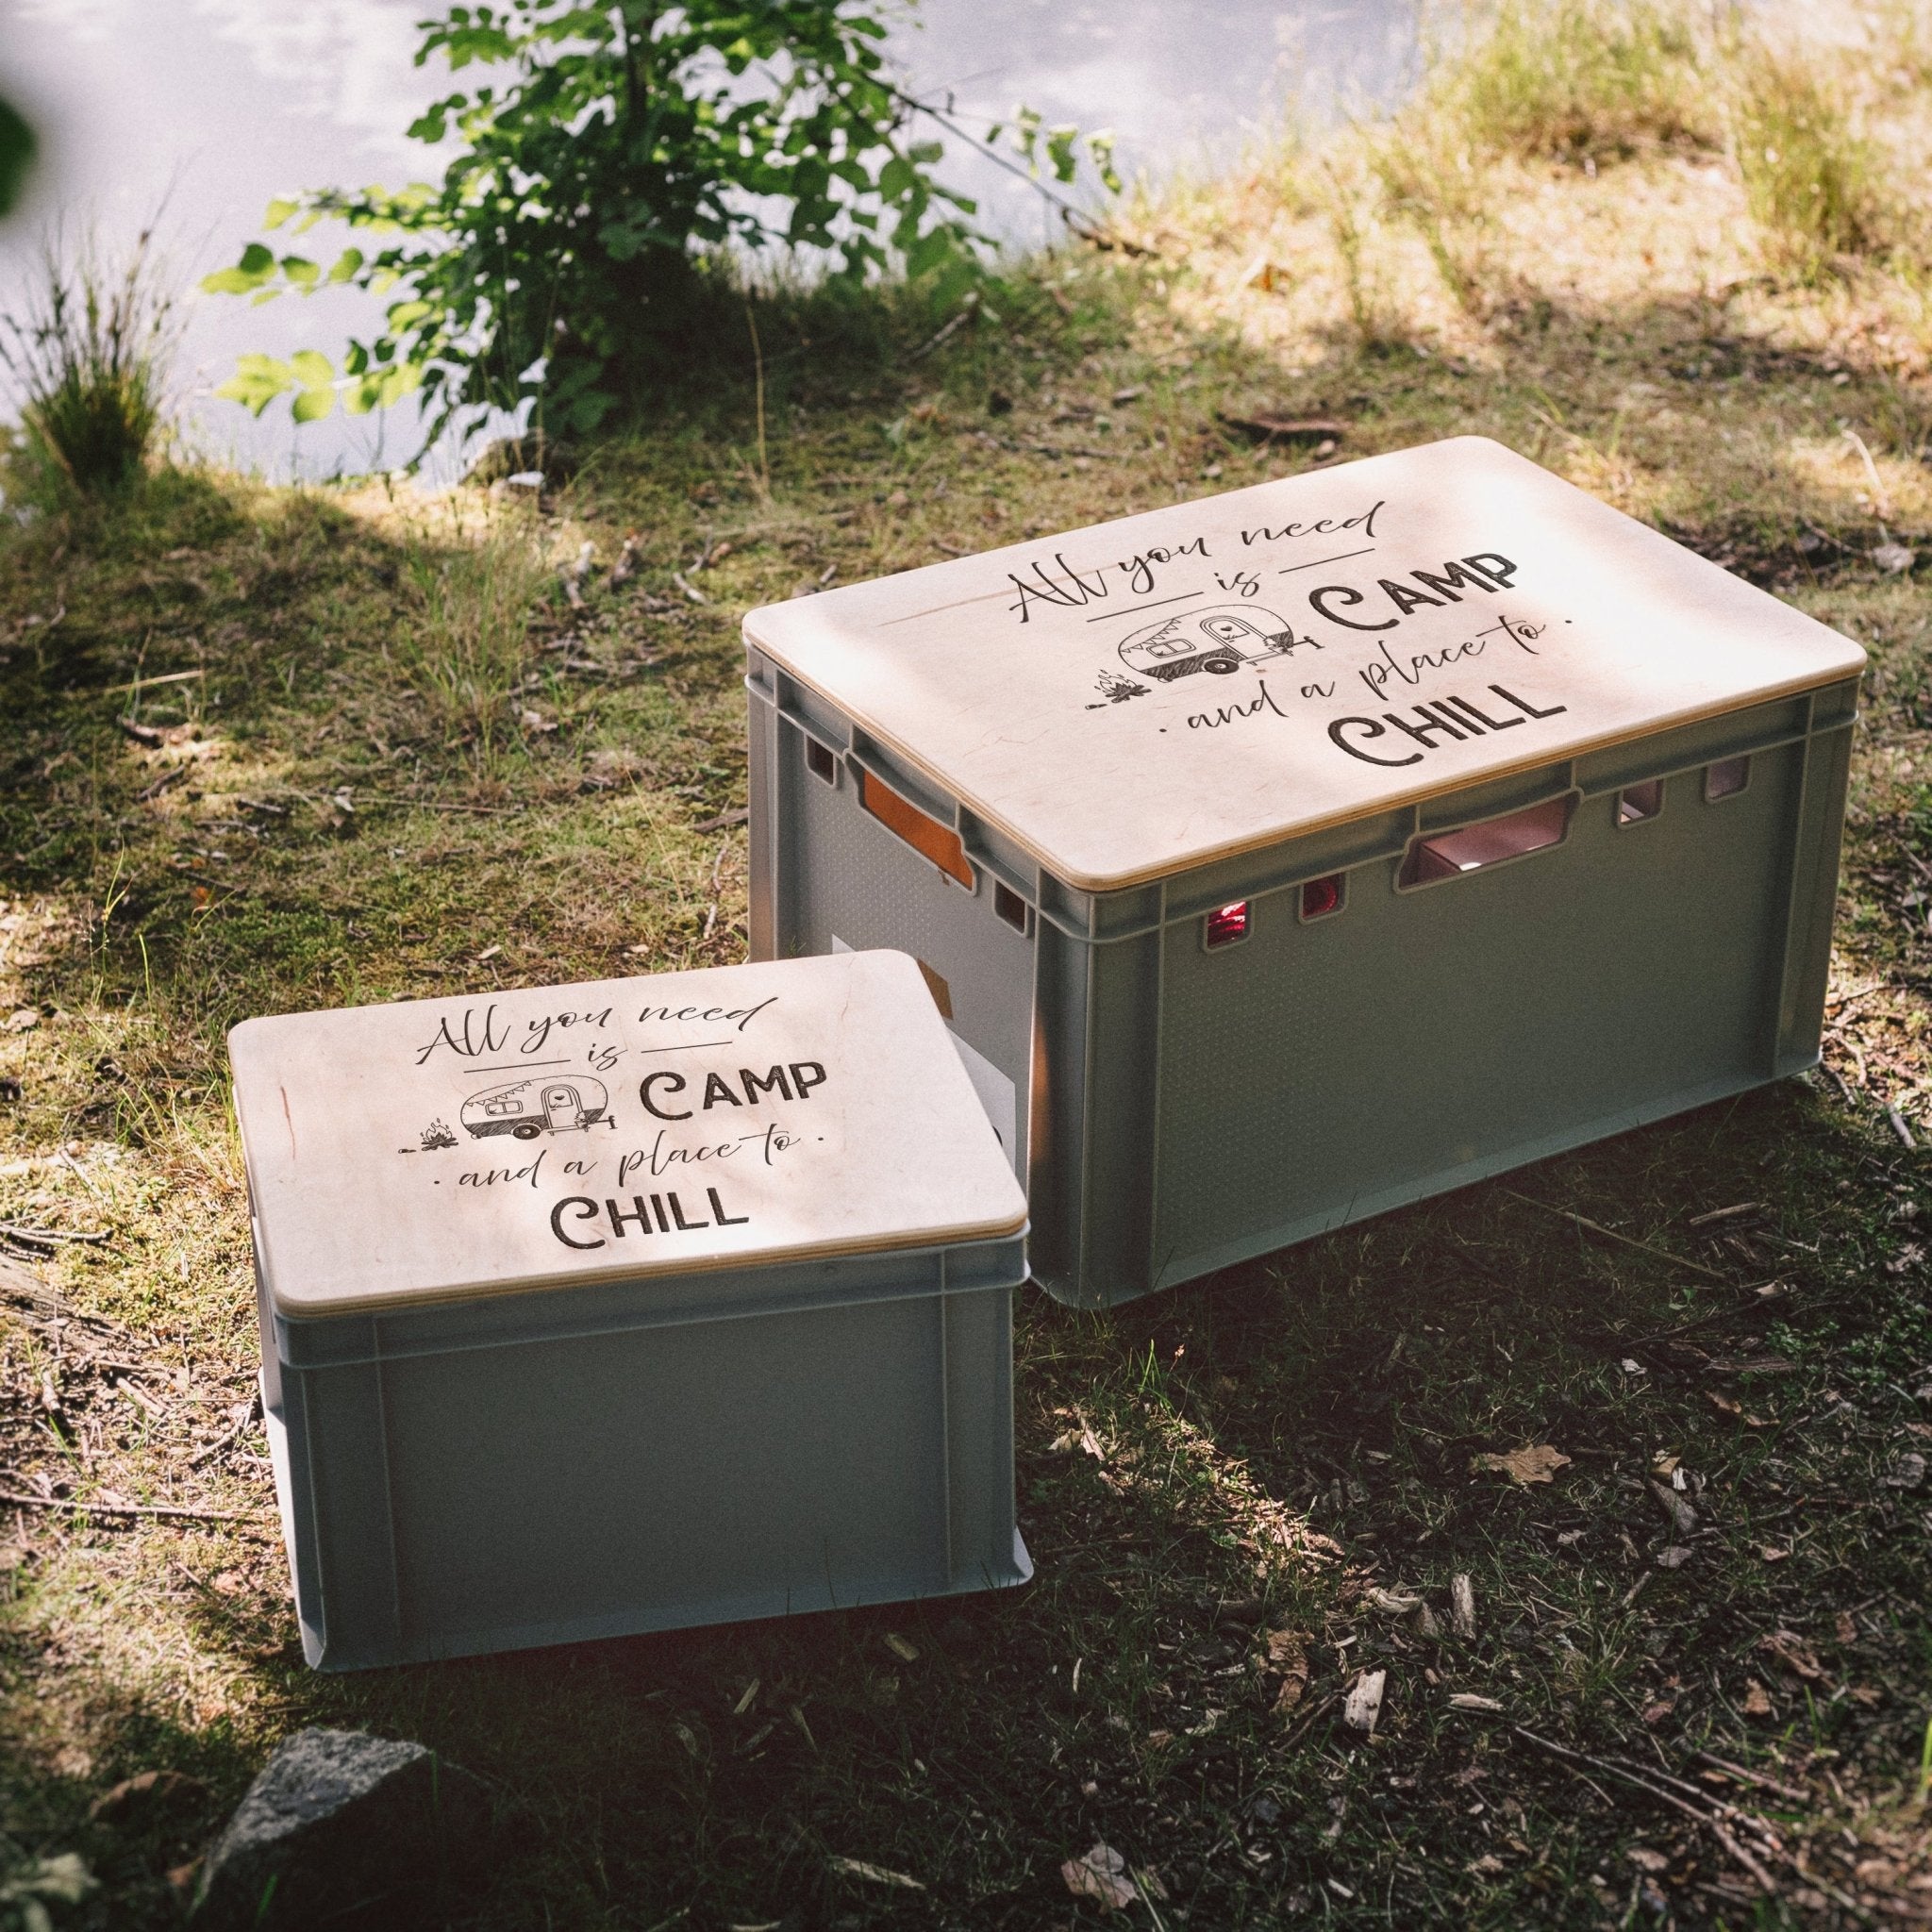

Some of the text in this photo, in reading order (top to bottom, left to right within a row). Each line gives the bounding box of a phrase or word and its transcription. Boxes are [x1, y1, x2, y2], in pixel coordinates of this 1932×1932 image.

[1008, 501, 1385, 624] All you need
[1214, 570, 1261, 597] is
[1308, 552, 1518, 631] CAMP
[1188, 615, 1546, 730] and a place to
[1327, 685, 1567, 768] CHILL
[415, 997, 778, 1065] All you need
[588, 1042, 628, 1072] is
[640, 1061, 827, 1121] CAMP
[458, 1124, 801, 1189] and a place to
[551, 1188, 750, 1250] CHILL
